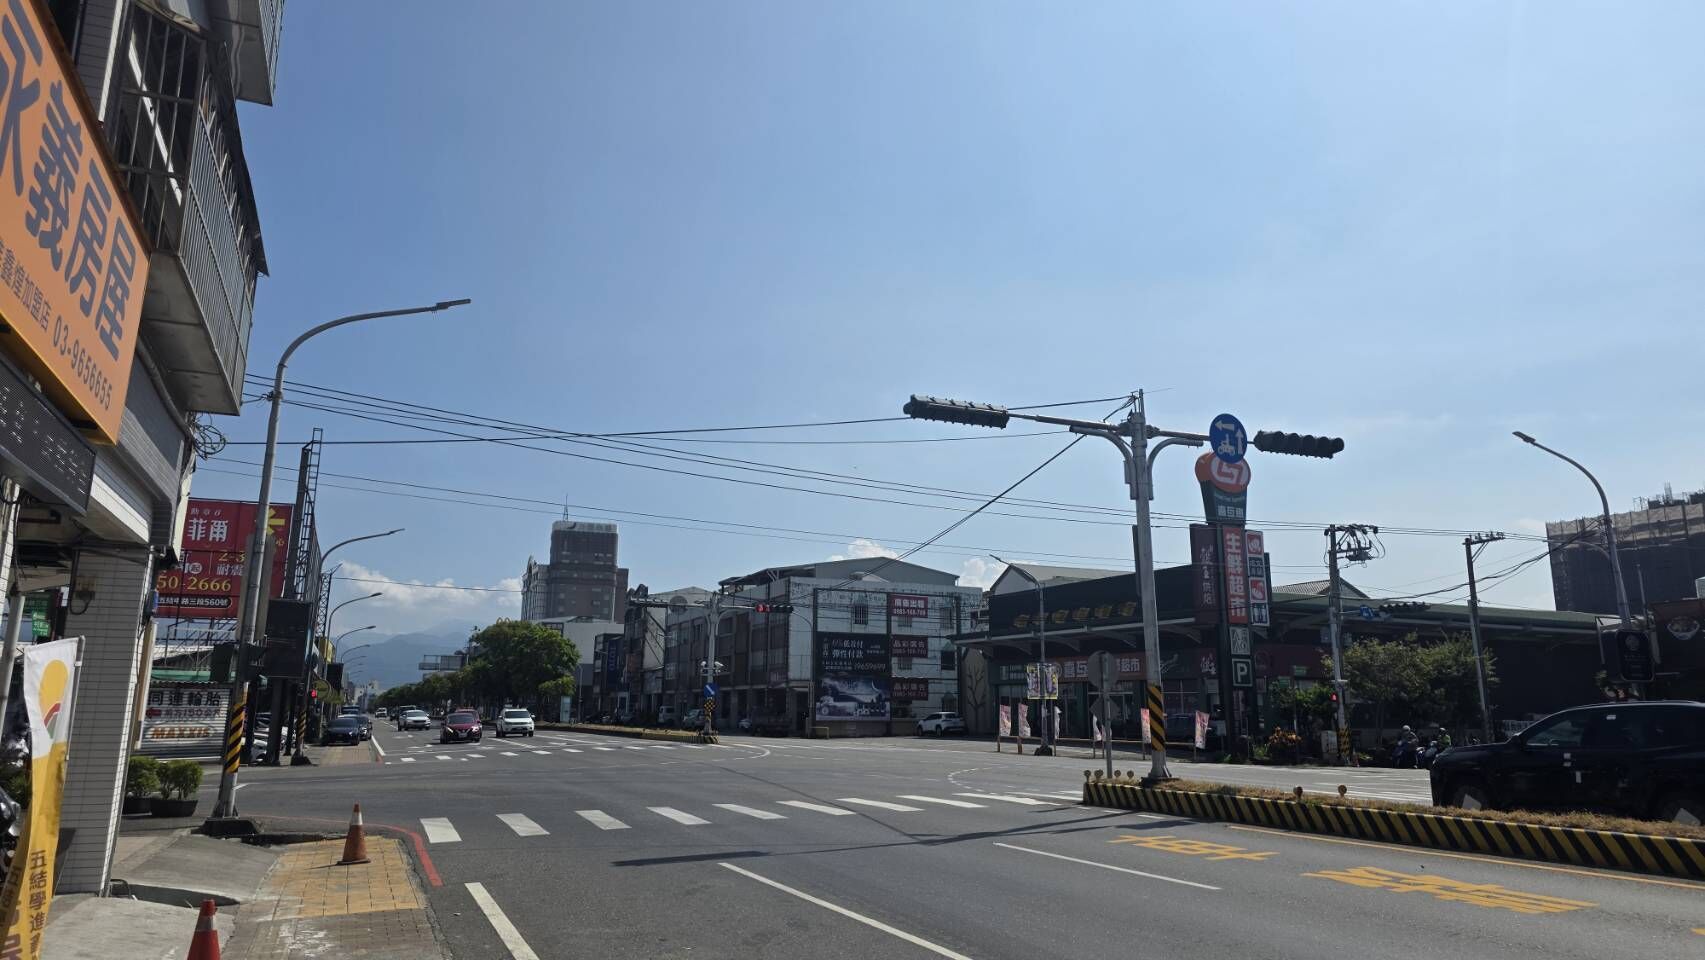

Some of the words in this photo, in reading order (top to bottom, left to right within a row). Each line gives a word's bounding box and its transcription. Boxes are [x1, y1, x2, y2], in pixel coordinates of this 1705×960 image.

[0, 0, 136, 360] 永義房屋
[53, 314, 112, 412] 03-9656655
[187, 517, 229, 542] 菲爾
[1225, 532, 1247, 617] 生鮮超市
[1236, 663, 1248, 682] P
[151, 726, 210, 739] MAXXIS
